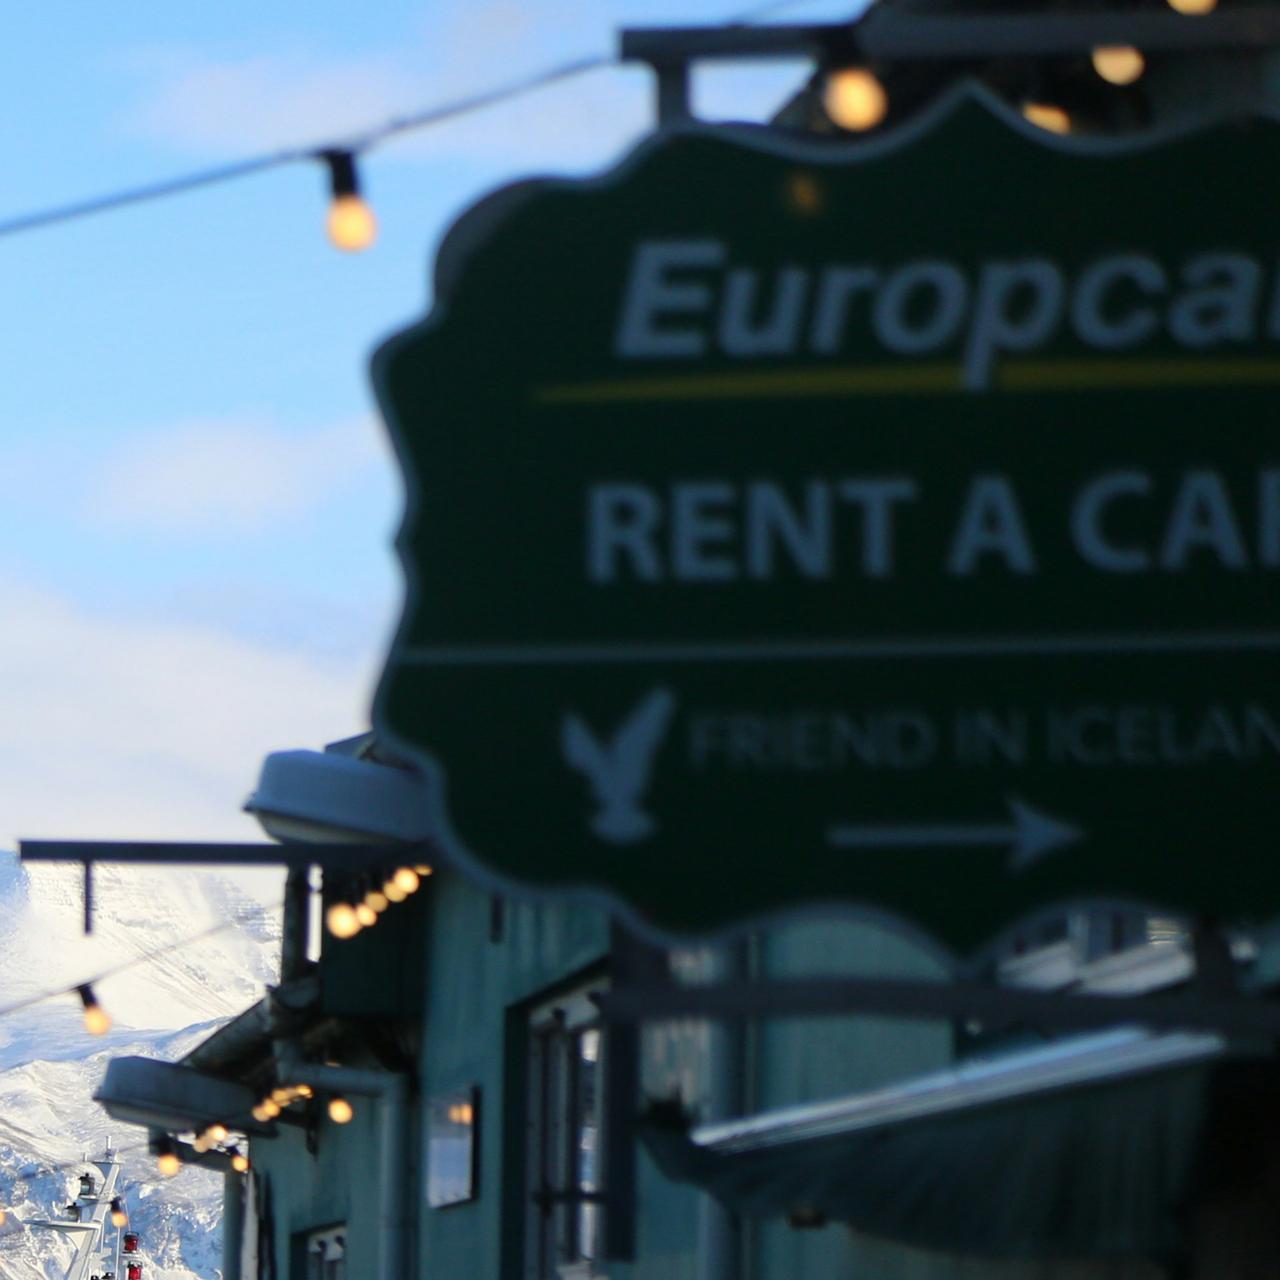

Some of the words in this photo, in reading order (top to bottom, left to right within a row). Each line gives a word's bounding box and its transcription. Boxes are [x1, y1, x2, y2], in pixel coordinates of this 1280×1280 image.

[616, 236, 1280, 392] Europca
[585, 475, 919, 583] RENT
[947, 474, 1037, 577] A
[1069, 470, 1280, 574] CA
[688, 709, 938, 771] FRIEND
[954, 705, 1028, 767] IN
